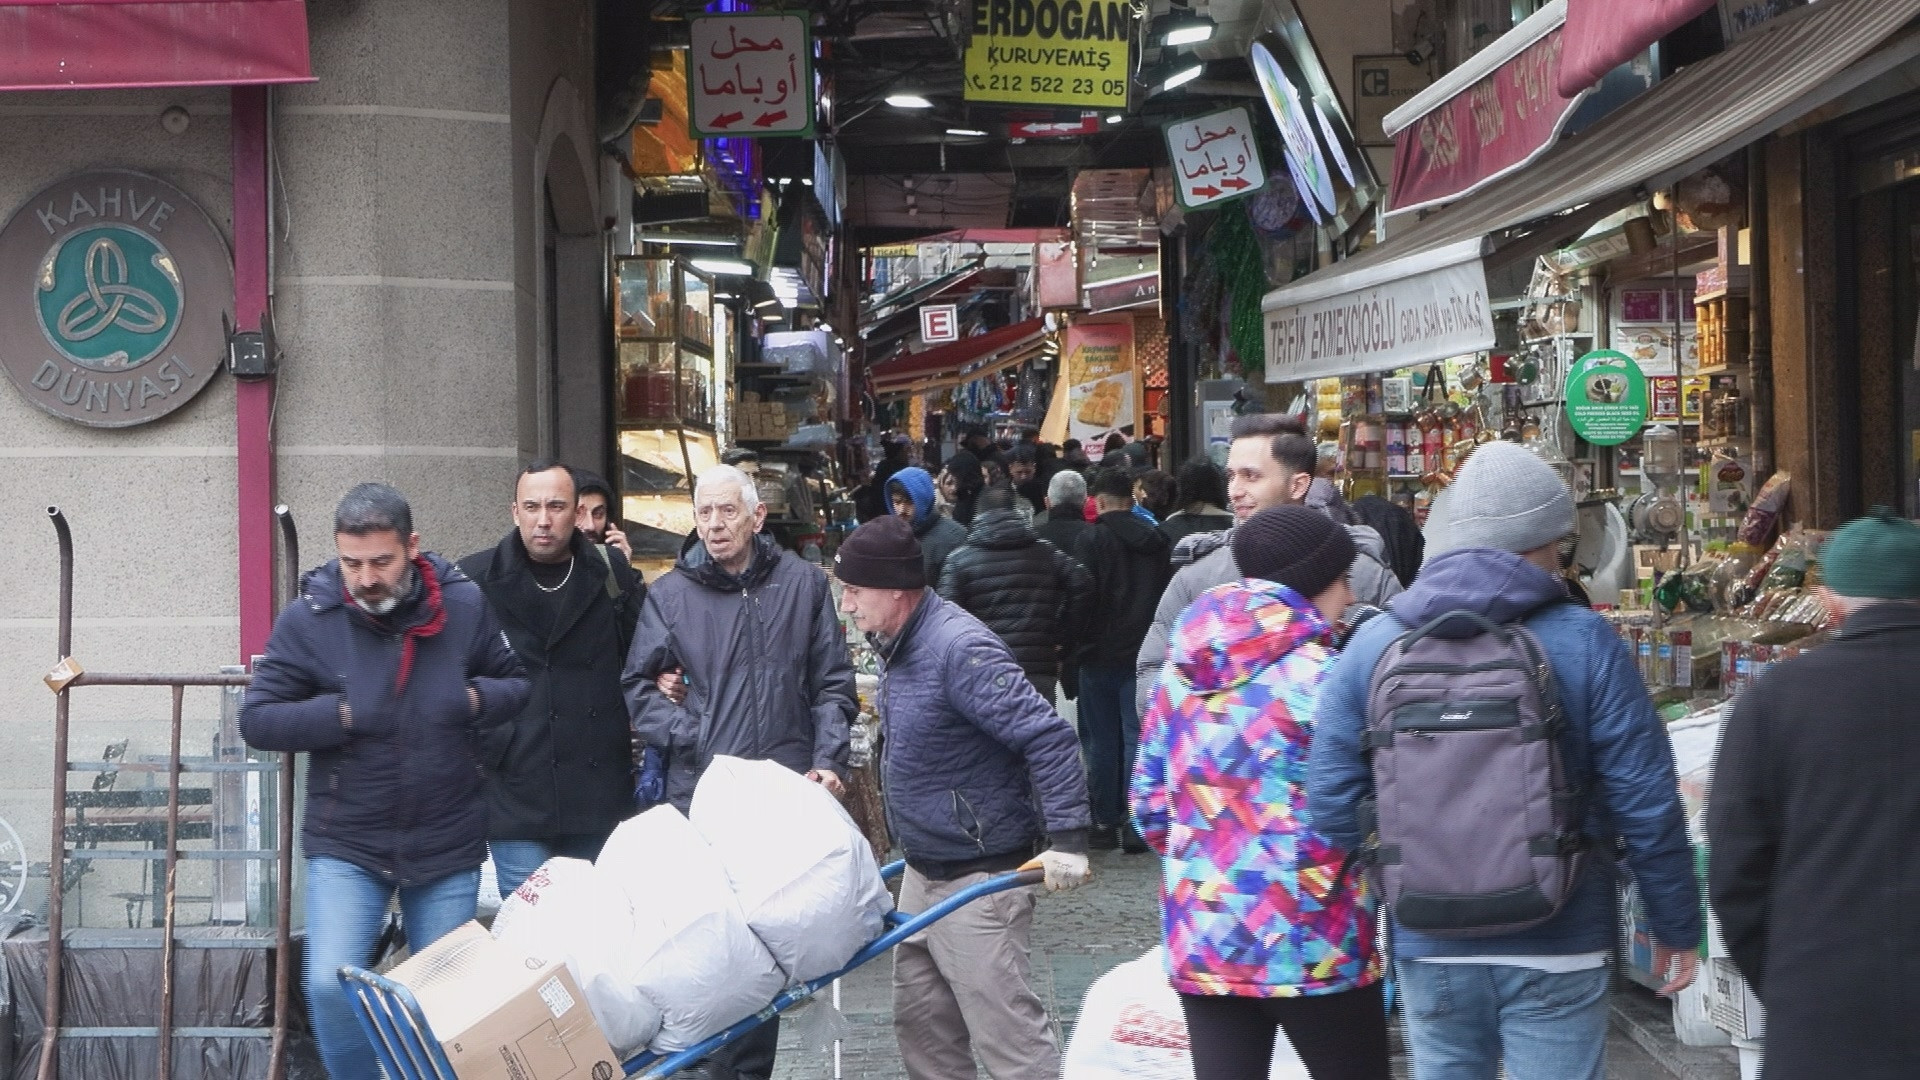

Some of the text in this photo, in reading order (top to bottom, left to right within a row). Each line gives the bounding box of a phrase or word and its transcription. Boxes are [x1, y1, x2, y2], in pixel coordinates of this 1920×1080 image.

[711, 25, 783, 59] محل
[699, 53, 797, 105] أوباما
[990, 75, 1124, 95] 212 522 23 05
[1180, 134, 1252, 179] أوباما
[1185, 125, 1236, 151] محل
[36, 187, 175, 234] KAHVE
[929, 312, 948, 336] E
[1311, 291, 1396, 362] EKMEKÇİOĞLU
[1400, 308, 1421, 344] GIDA
[31, 354, 195, 413] DÜNYASI
